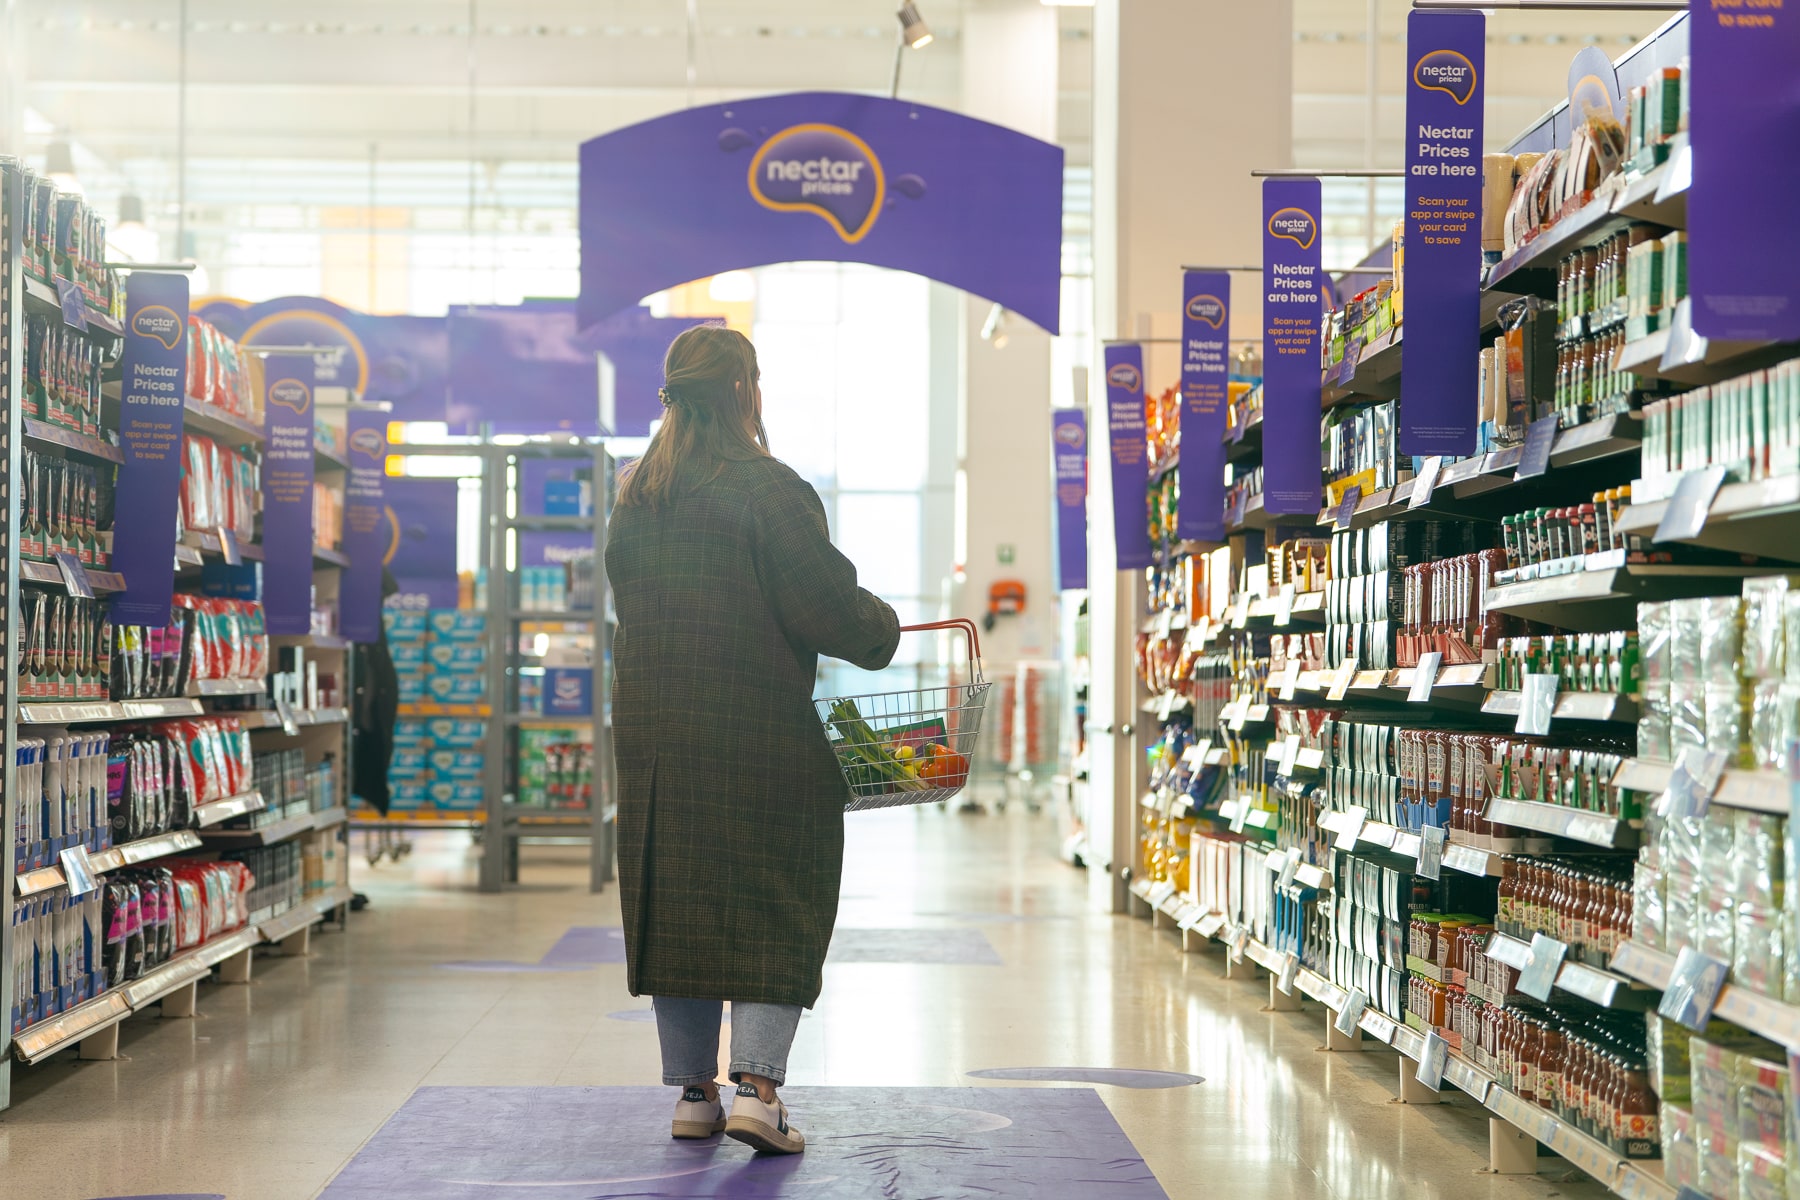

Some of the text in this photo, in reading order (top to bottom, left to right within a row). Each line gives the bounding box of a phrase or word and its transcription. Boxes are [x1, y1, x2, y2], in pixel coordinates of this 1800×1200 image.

[1718, 12, 1774, 28] to save
[1423, 65, 1467, 77] nectar
[1439, 75, 1462, 84] prices
[1419, 125, 1474, 139] Nectar
[1419, 143, 1470, 158] Prices
[767, 157, 864, 180] nectar
[1411, 162, 1476, 176] are here
[802, 180, 853, 197] prices
[1418, 196, 1468, 209] Scan your
[1411, 210, 1475, 222] app or swipe
[1275, 219, 1309, 228] nectar
[1419, 222, 1466, 234] your card
[1424, 236, 1461, 245] to save
[1273, 264, 1315, 275] Nectar
[1273, 278, 1312, 289] Prices
[1268, 292, 1318, 303] are here
[138, 317, 175, 328] nectar
[1273, 317, 1312, 327] Scan your
[1268, 328, 1284, 336] app
[1294, 327, 1317, 336] swipe
[1189, 339, 1223, 350] Nectar
[1274, 337, 1311, 346] your card
[1279, 346, 1287, 354] to
[1189, 351, 1221, 361] Prices
[134, 364, 179, 377] Nectar
[1184, 362, 1225, 372] are here
[133, 378, 175, 391] Prices
[127, 394, 180, 406] are here
[131, 420, 172, 430] Scan your
[125, 431, 142, 439] app
[152, 432, 177, 441] swipe
[131, 441, 170, 450] your card
[737, 1086, 755, 1094] VEJA
